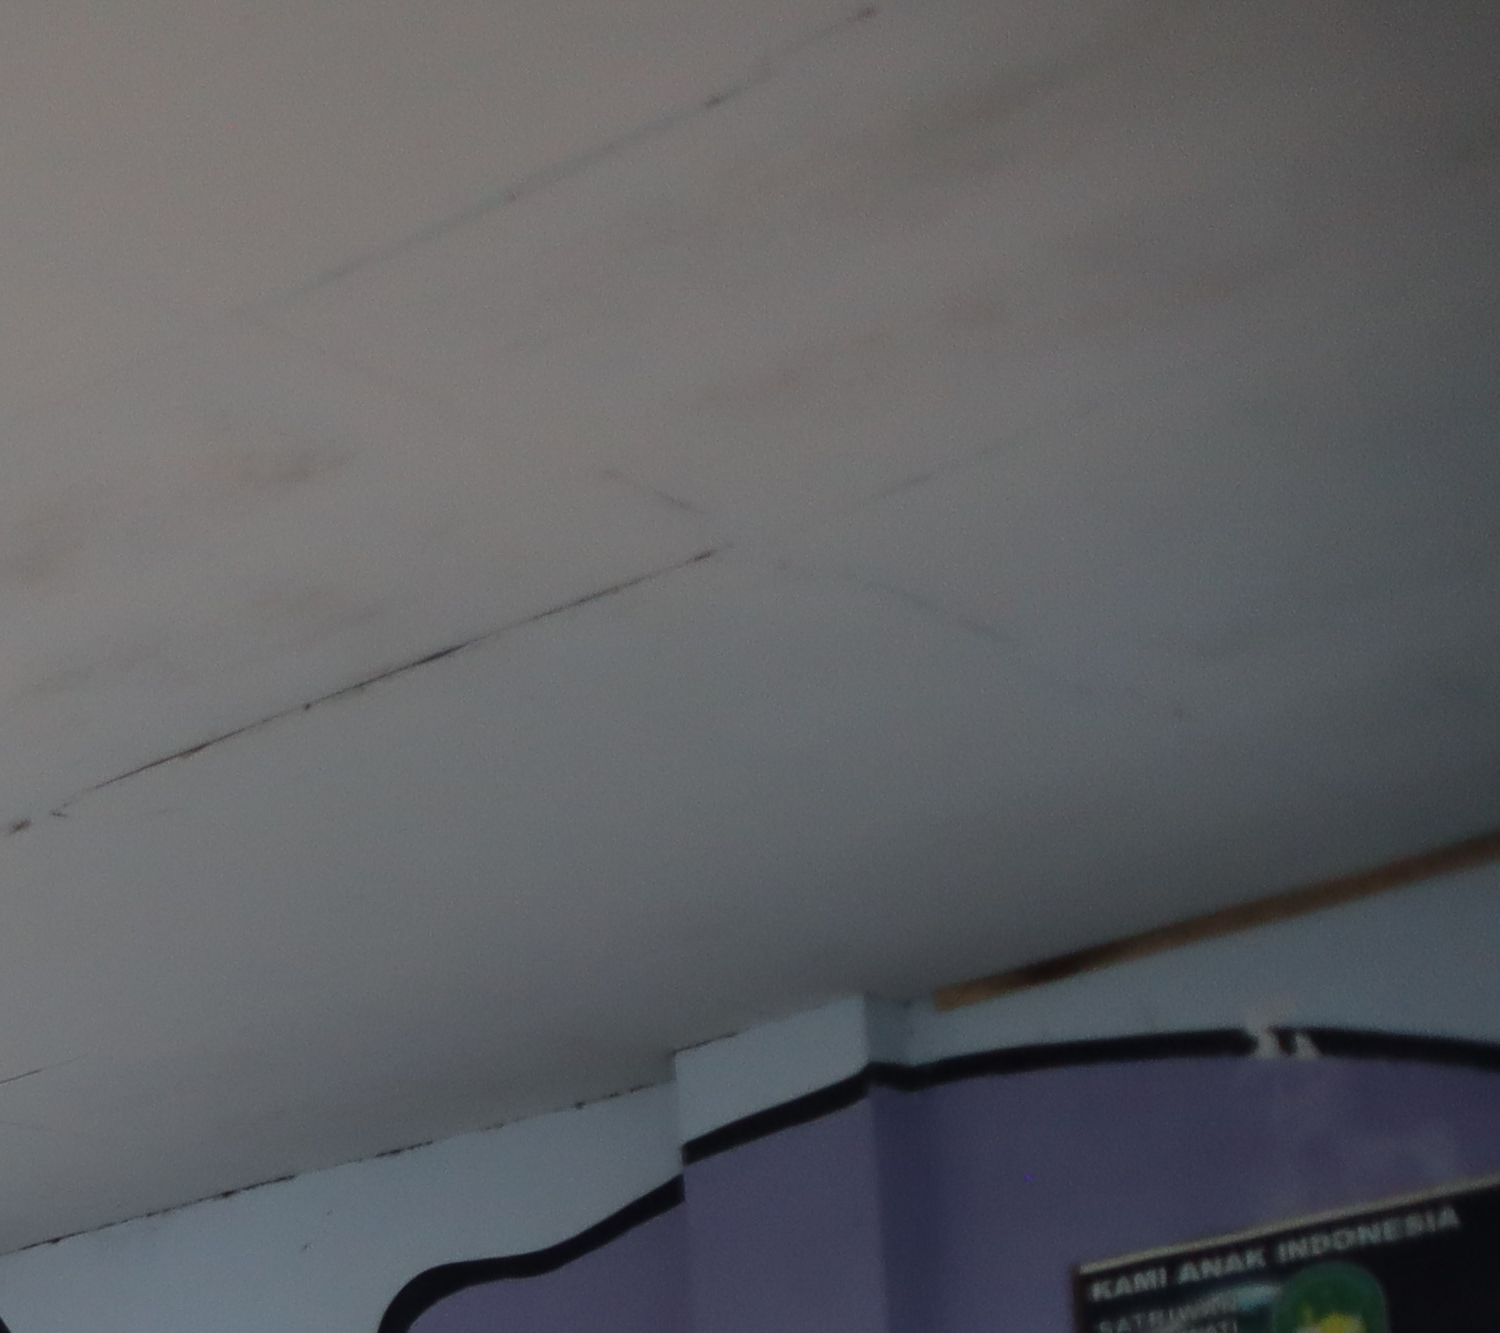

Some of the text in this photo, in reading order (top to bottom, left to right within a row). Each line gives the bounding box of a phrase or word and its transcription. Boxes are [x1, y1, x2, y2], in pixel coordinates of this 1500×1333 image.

[1090, 1204, 1462, 1301] KAMI ANAK INDONESIA
